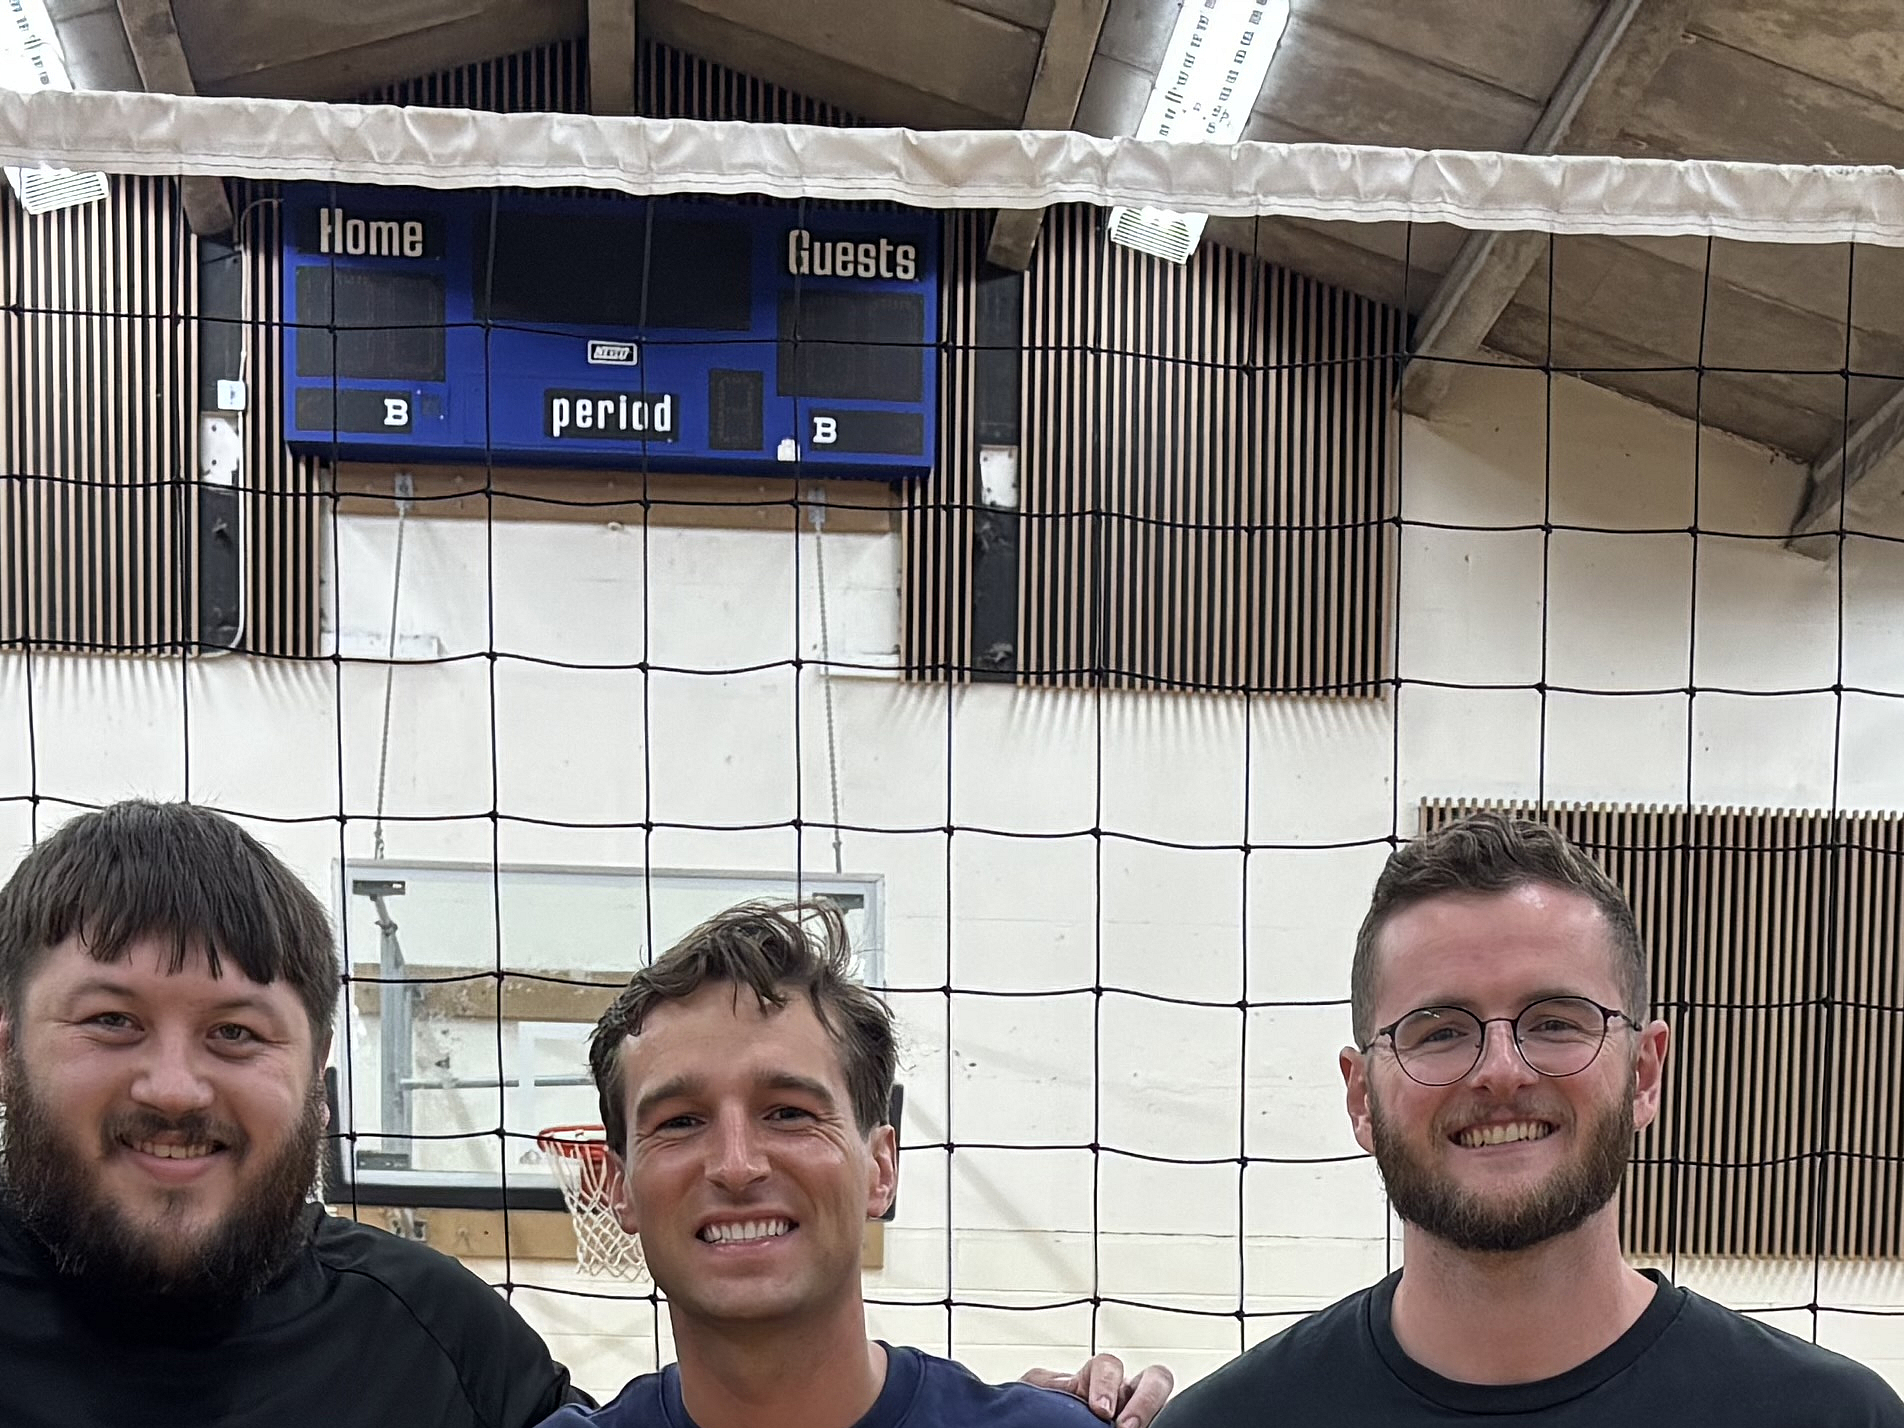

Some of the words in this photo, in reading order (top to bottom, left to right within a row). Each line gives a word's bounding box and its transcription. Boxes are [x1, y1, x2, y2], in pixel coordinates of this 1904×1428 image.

[319, 208, 424, 257] Home
[788, 229, 917, 281] Guests
[383, 398, 408, 426] B
[552, 394, 672, 437] period
[812, 416, 838, 445] B
